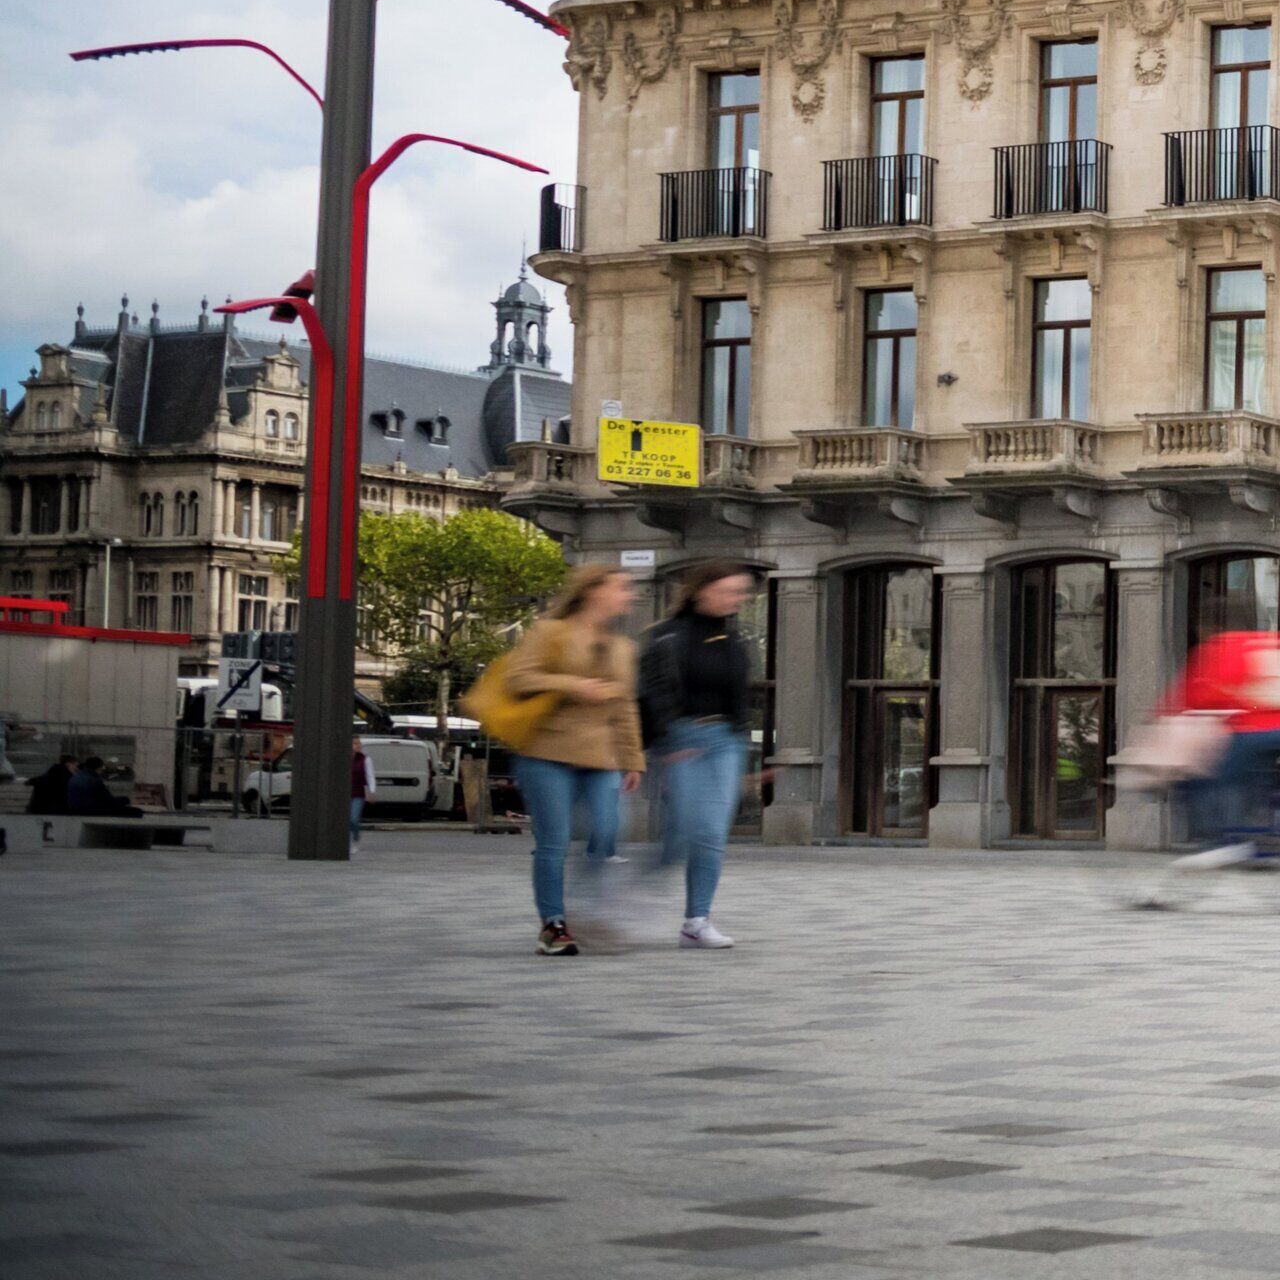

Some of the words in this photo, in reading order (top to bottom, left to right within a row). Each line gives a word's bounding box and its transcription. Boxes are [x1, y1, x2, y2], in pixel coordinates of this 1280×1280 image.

[607, 420, 625, 431] De
[622, 451, 635, 459] TE
[642, 453, 676, 462] KOOP
[606, 465, 622, 474] 03
[627, 466, 651, 476] 227
[655, 469, 672, 478] 06
[676, 470, 691, 479] 36
